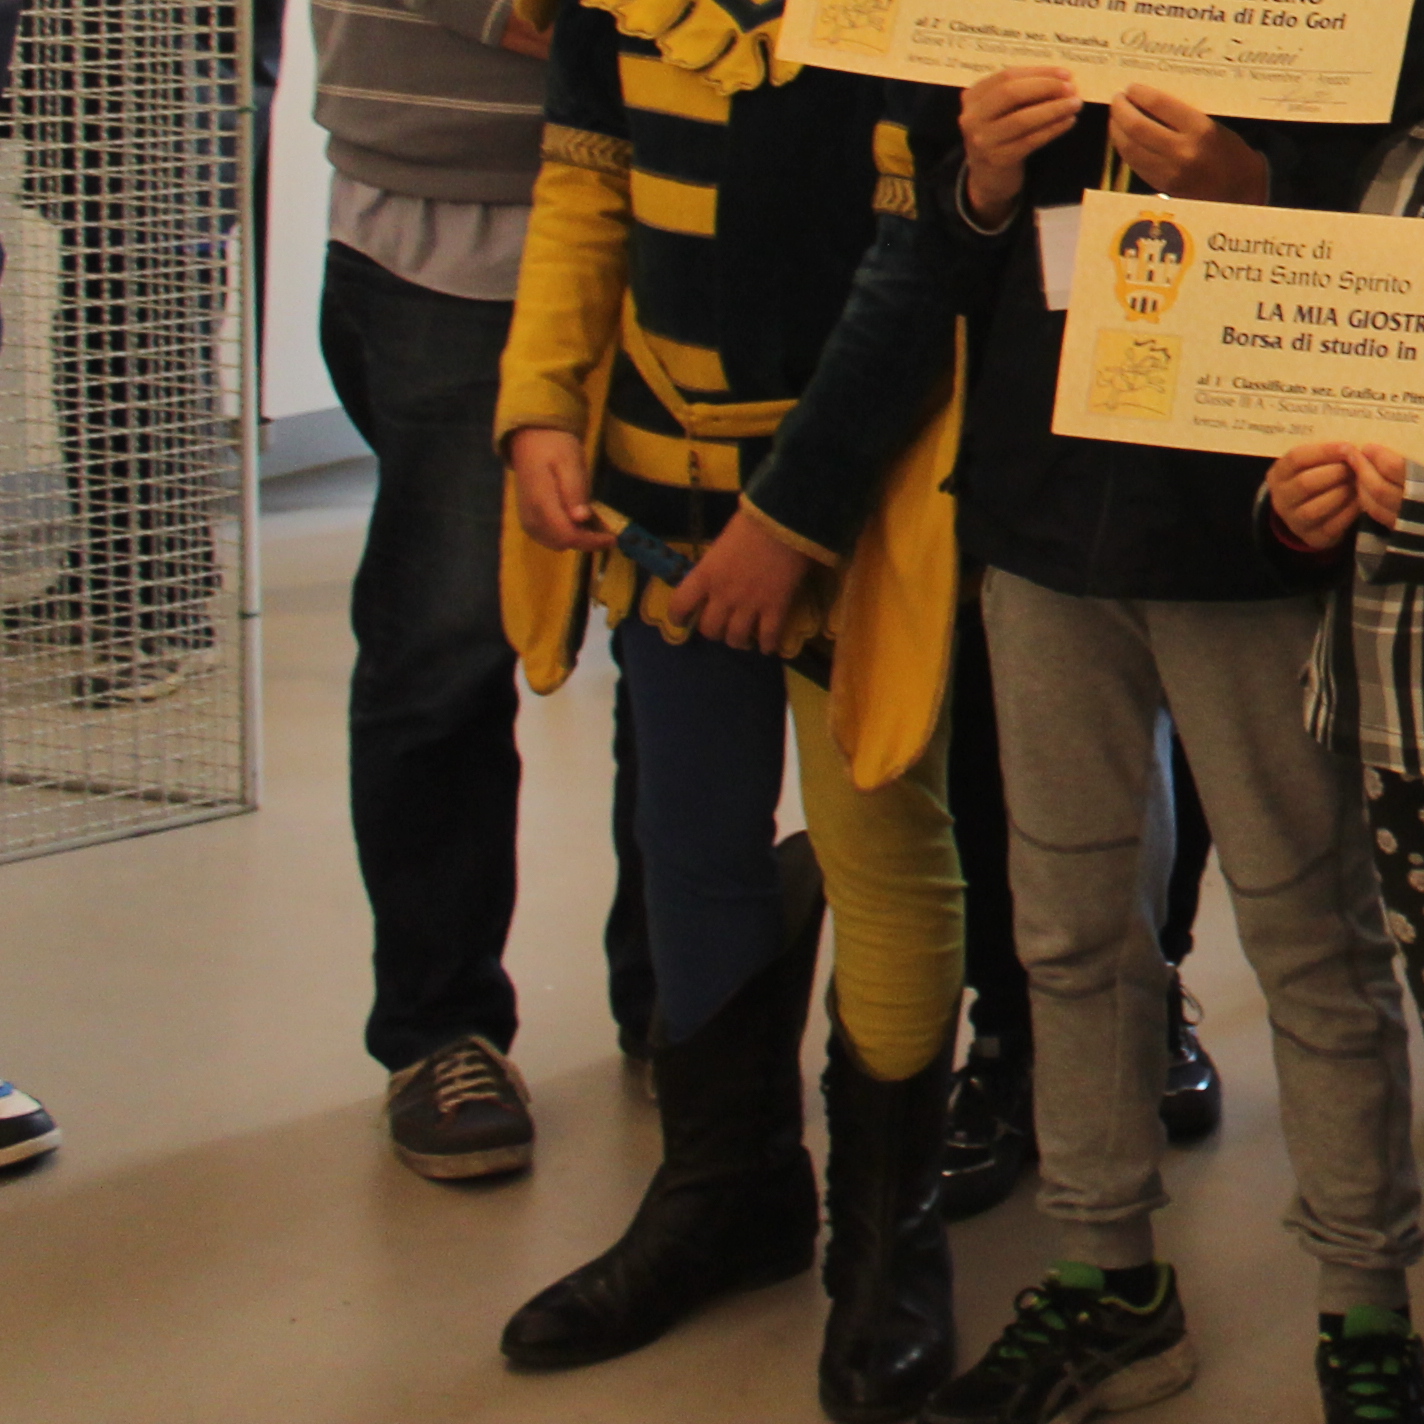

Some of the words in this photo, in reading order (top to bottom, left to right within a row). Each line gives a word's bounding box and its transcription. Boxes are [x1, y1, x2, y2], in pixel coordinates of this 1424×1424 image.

[1134, 0, 1225, 23] memoria
[1234, 7, 1253, 25] di
[1260, 10, 1297, 28] Edo
[1306, 12, 1347, 30] Gori
[1120, 29, 1211, 58] Davide
[1208, 232, 1306, 259] Quartiere
[1312, 239, 1332, 259] di
[1203, 259, 1262, 282] Porta
[1270, 265, 1331, 288] Santo
[1338, 270, 1411, 294] Spirito
[1256, 301, 1283, 322] LA
[1294, 304, 1338, 327] MIA
[1222, 326, 1283, 349] Borsa
[1291, 333, 1312, 352] di
[1320, 337, 1389, 358] studio
[1397, 342, 1417, 361] in
